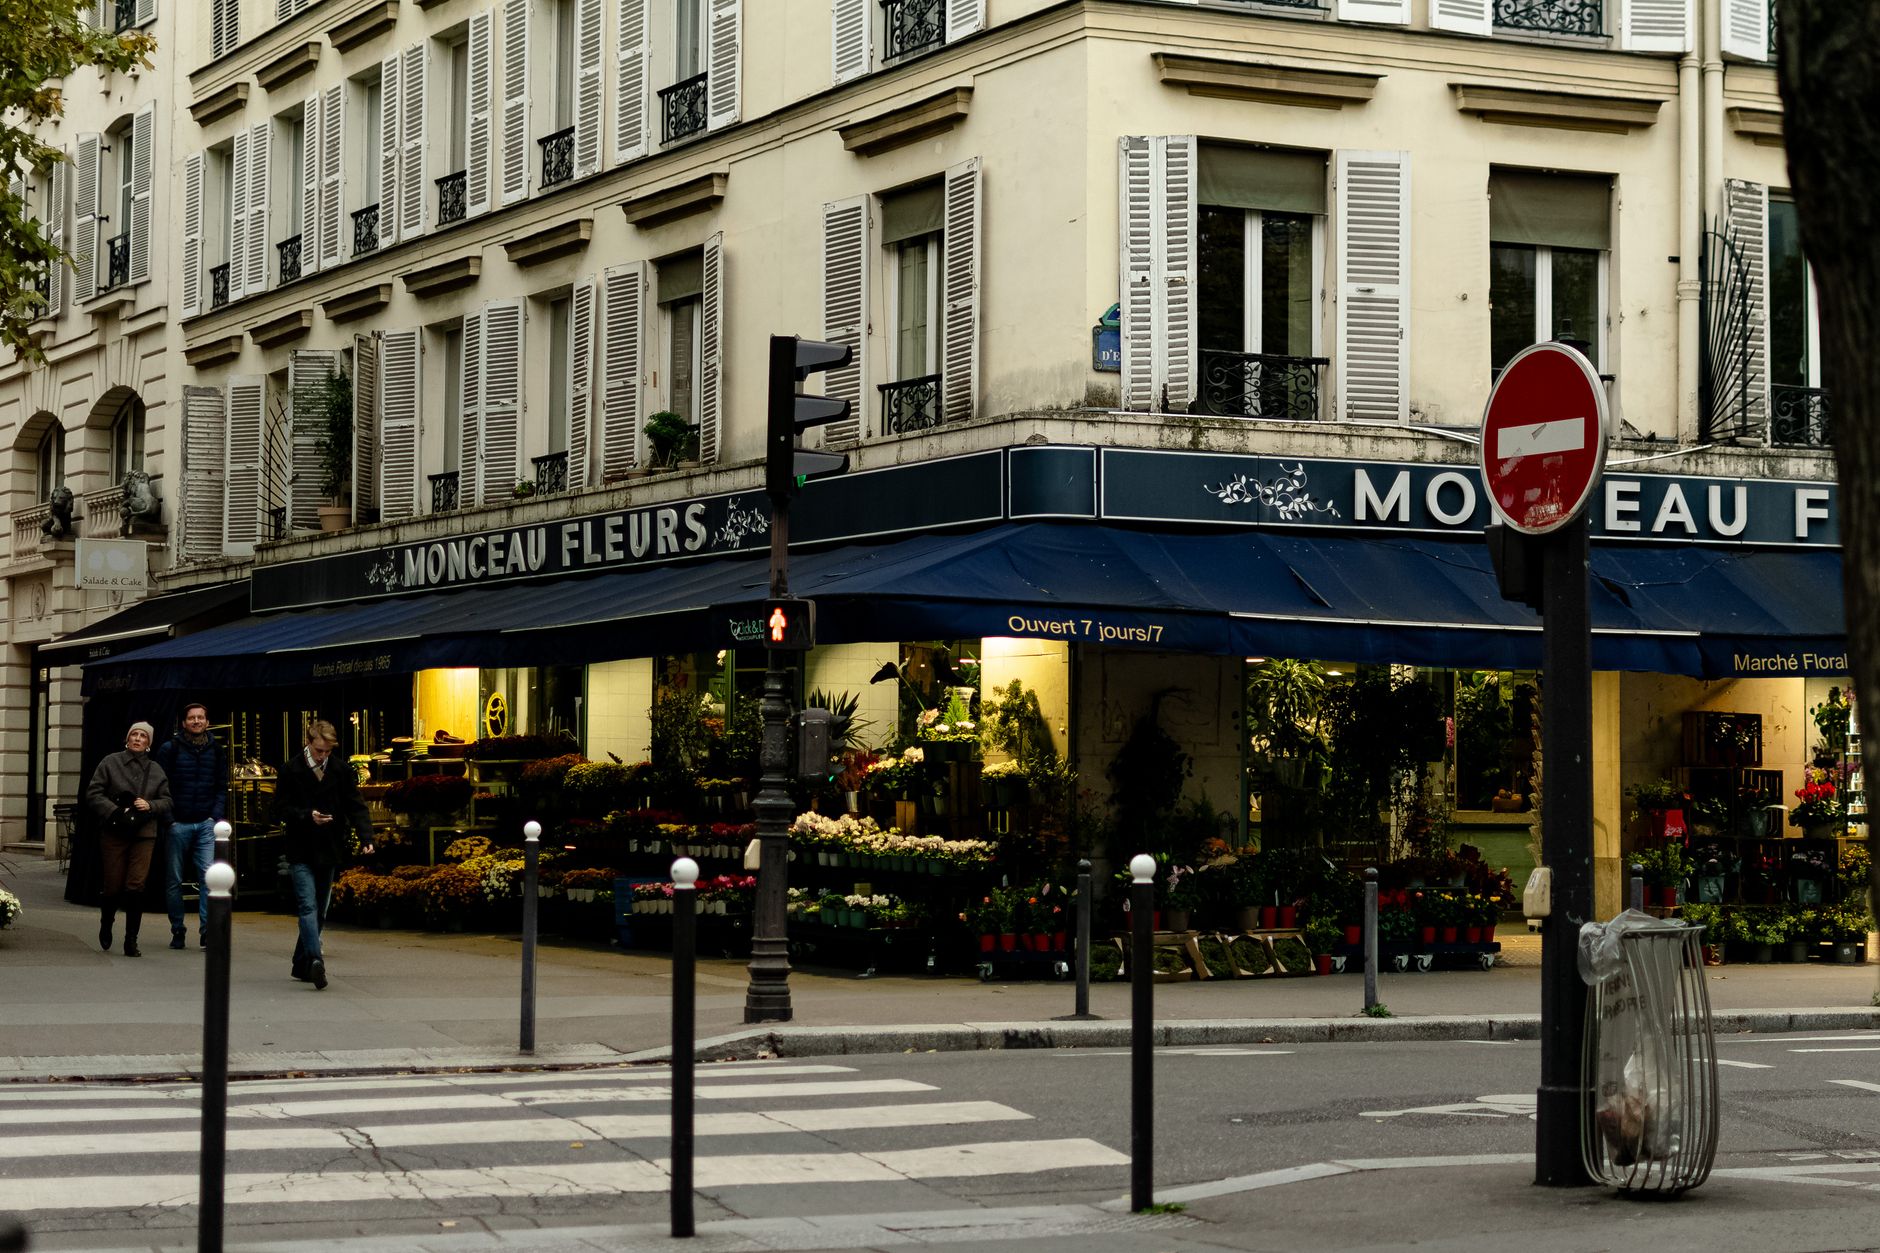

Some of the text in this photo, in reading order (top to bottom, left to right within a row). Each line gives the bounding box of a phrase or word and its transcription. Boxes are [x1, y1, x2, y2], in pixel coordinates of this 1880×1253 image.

[1354, 468, 1748, 537] MOEAU
[404, 503, 707, 588] MONCEAU FLEURS
[82, 575, 142, 586] Salade & Cake
[1008, 616, 1164, 643] Ouvert 7 jours/7
[1734, 653, 1848, 671] Marché Floral
